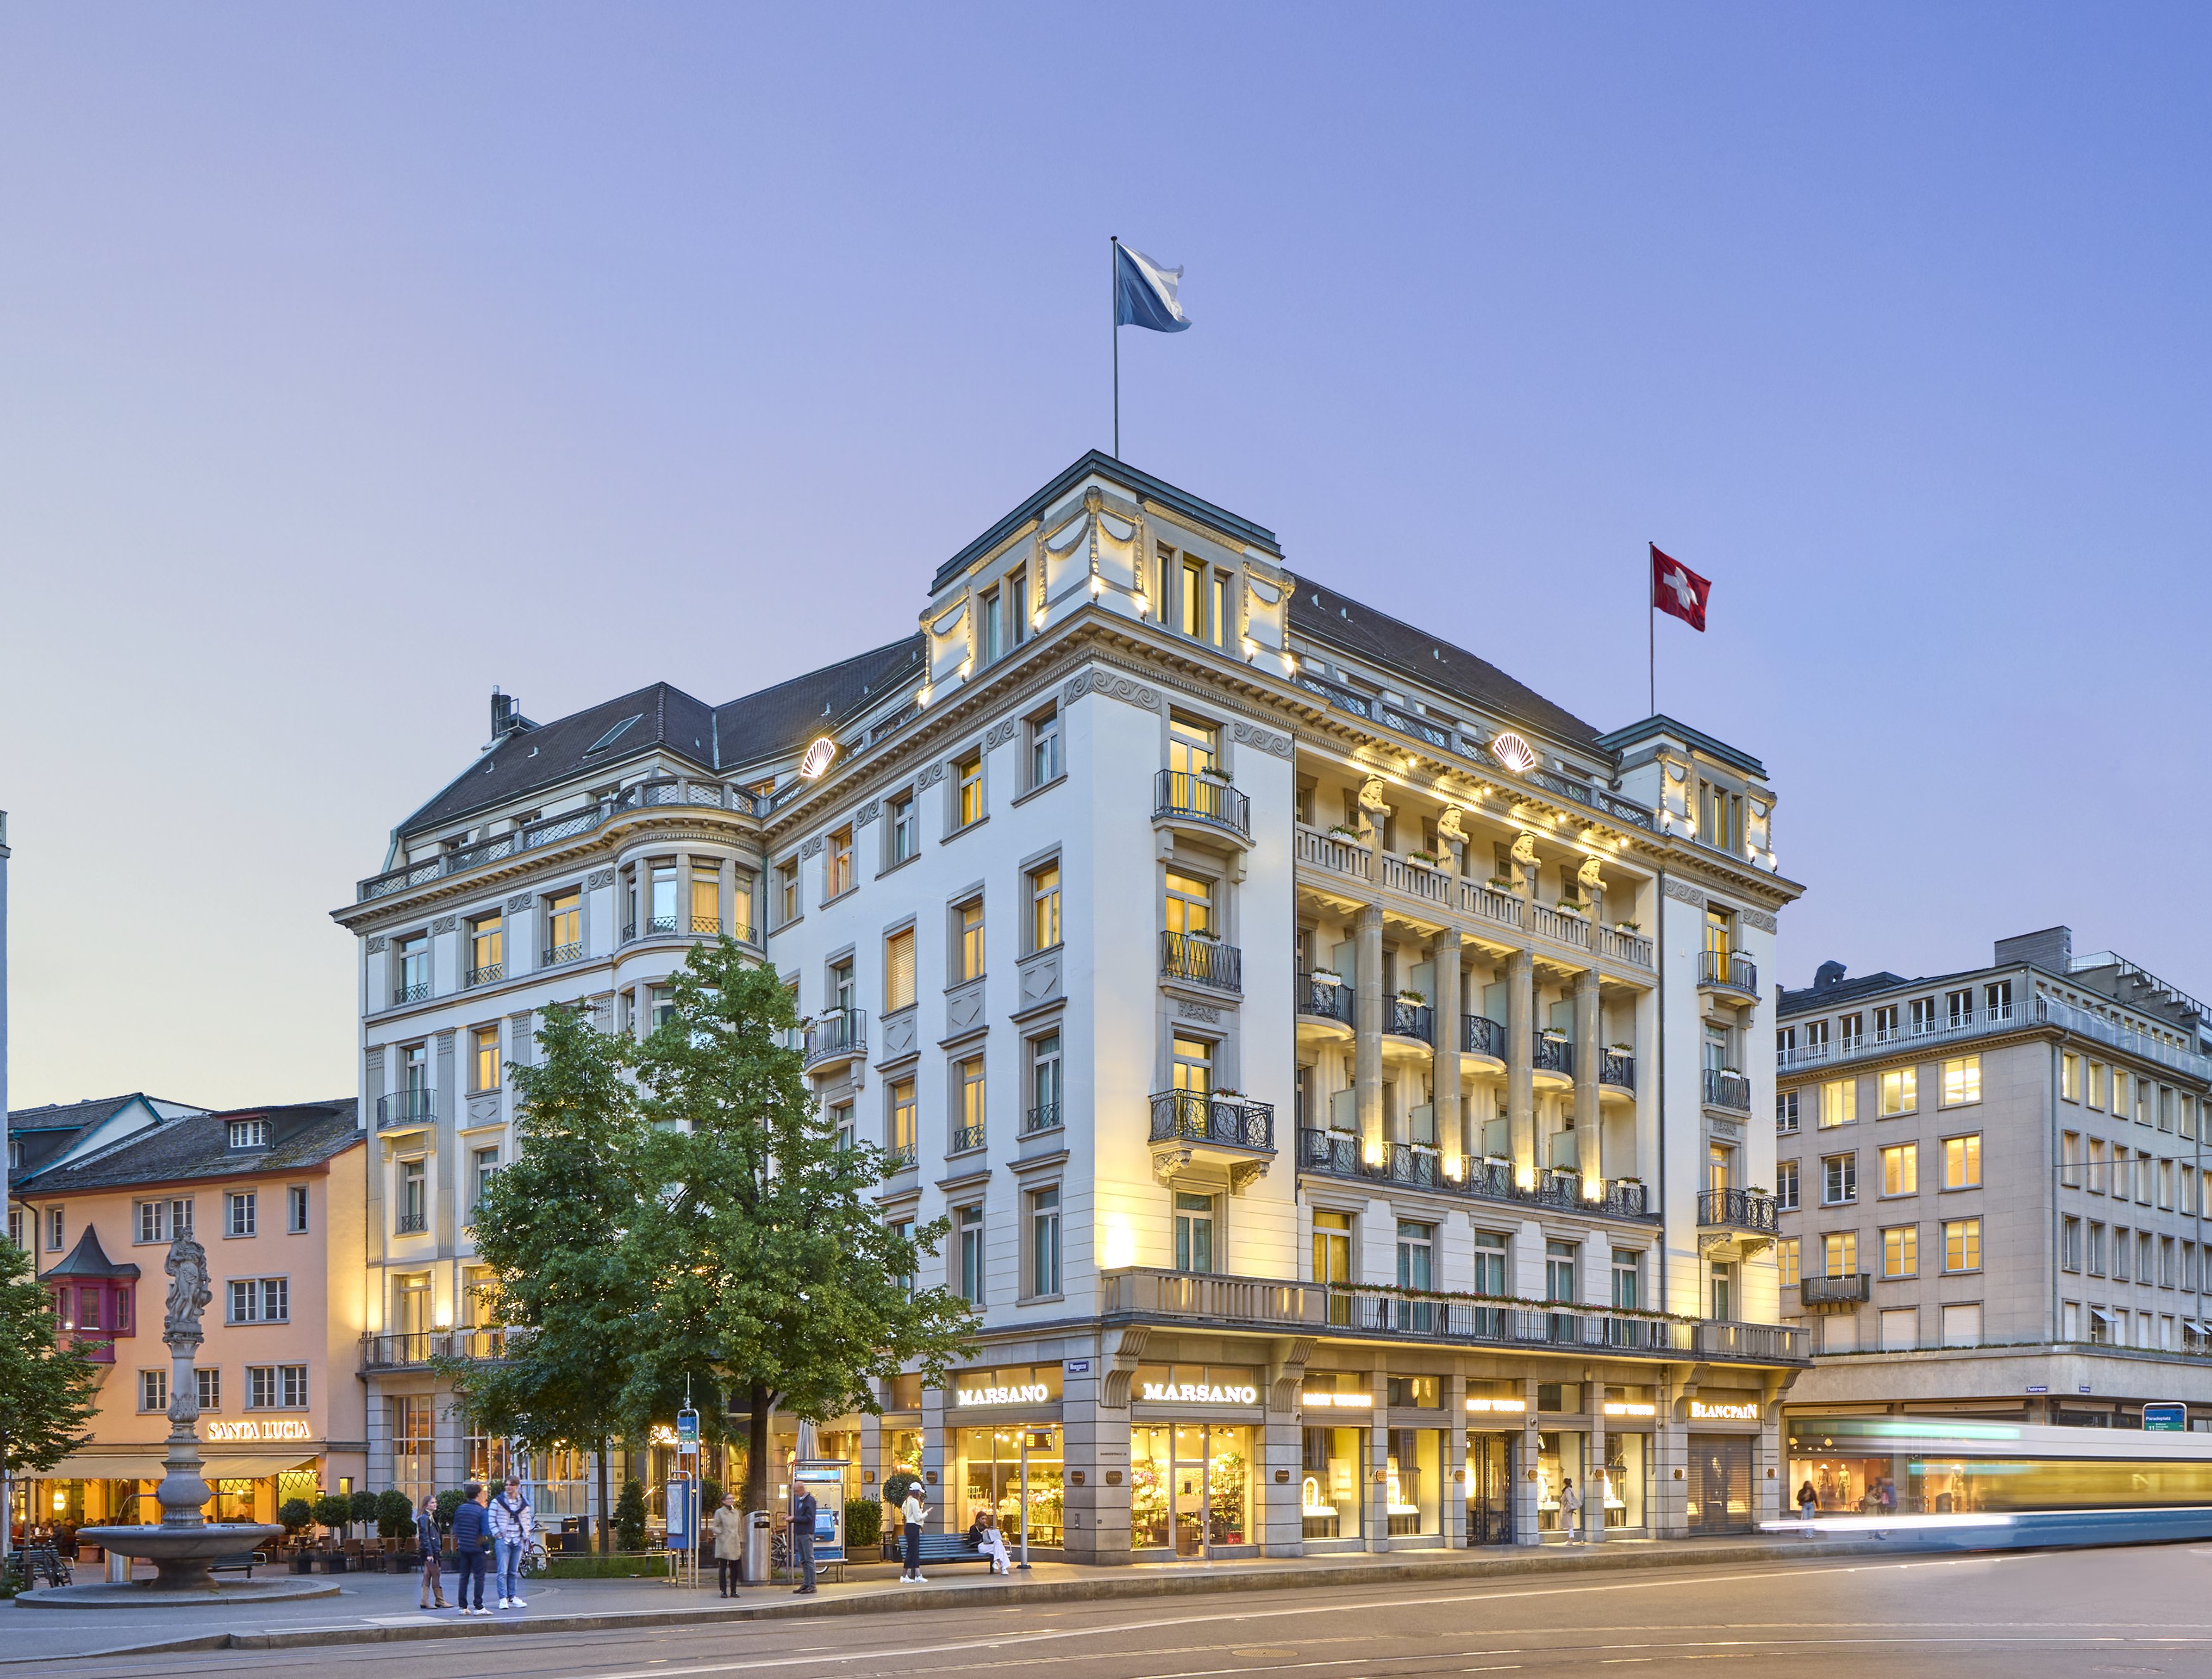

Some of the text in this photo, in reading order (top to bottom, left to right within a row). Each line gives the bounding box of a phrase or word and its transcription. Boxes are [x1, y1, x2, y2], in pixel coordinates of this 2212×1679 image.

[958, 1384, 1047, 1405] MARSANO
[1143, 1383, 1256, 1403] MARSANO
[1691, 1402, 1757, 1419] BLANCPAIN
[208, 1421, 311, 1440] SANTA LUCIA
